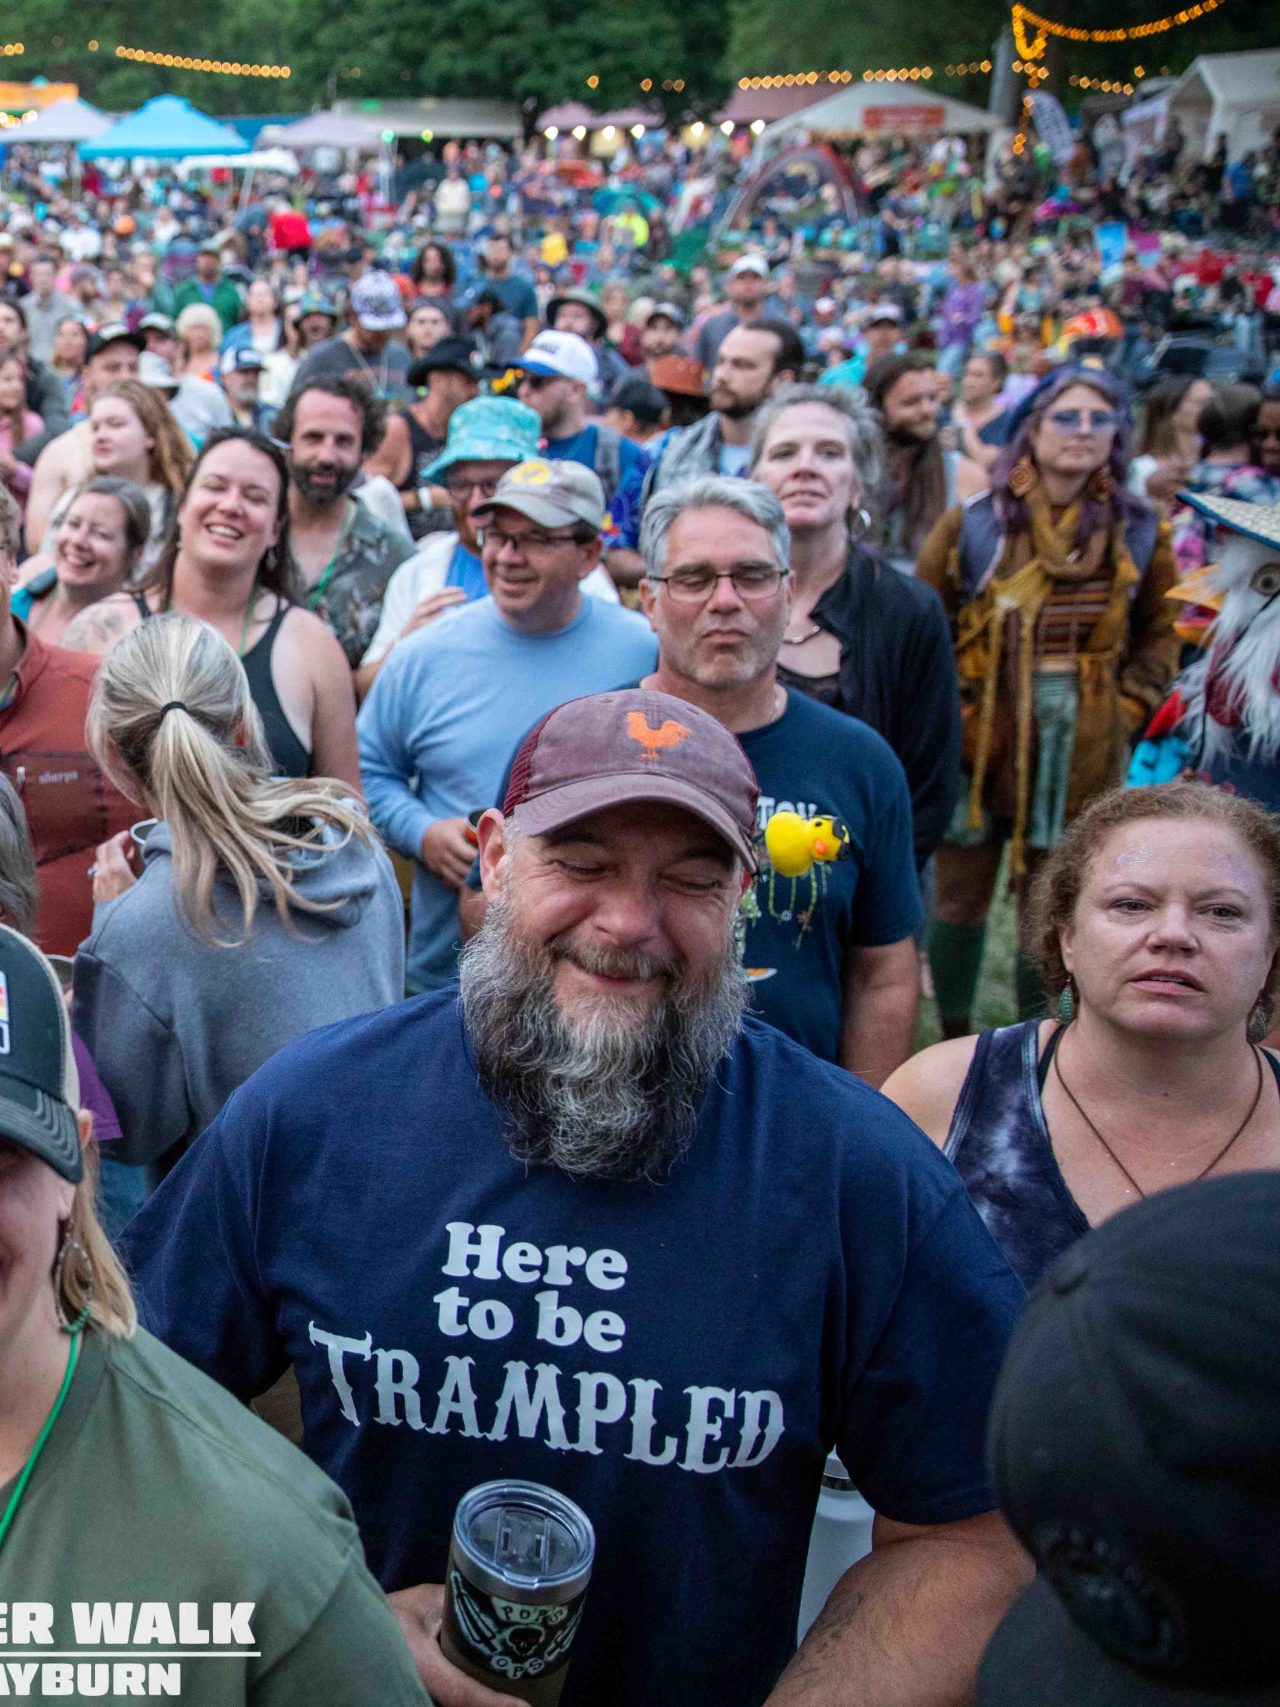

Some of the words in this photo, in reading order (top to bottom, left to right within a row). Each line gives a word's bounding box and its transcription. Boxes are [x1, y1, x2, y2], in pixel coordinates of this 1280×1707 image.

[441, 1221, 628, 1291] Here
[433, 1286, 514, 1341] to
[535, 1290, 626, 1353] be
[308, 1320, 786, 1474] TRAMPLED
